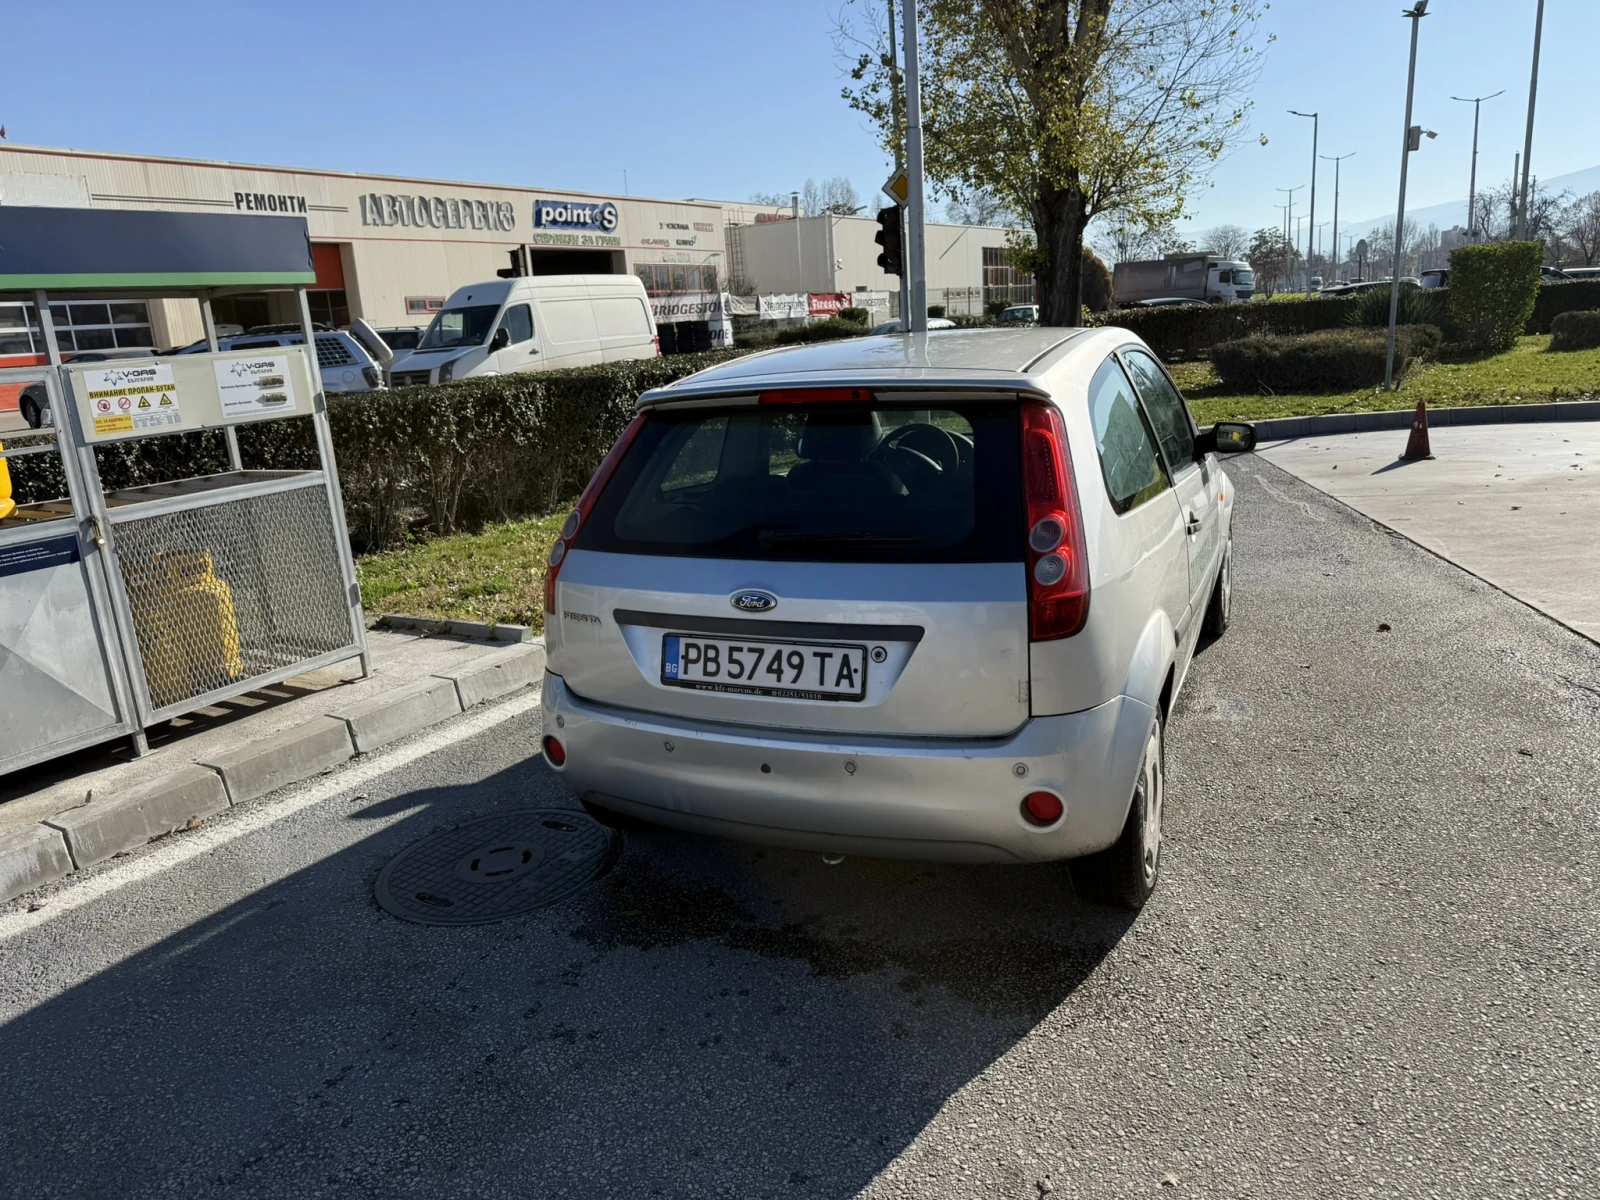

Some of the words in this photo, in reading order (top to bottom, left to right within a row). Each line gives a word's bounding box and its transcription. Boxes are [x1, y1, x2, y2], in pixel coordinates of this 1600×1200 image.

[234, 192, 307, 213] РЕМОНТИ
[541, 204, 592, 224] point
[603, 206, 617, 228] S
[246, 361, 275, 369] V-GAS
[122, 369, 157, 377] V-GAS
[89, 388, 127, 399] ВНИМАНИЕ
[128, 384, 175, 395] ПРОПАН-БУТАН
[739, 595, 765, 608] Ford
[563, 611, 602, 624] FIESTA
[665, 662, 678, 673] BG
[683, 642, 721, 677] PB
[727, 646, 805, 684] 5749
[812, 651, 855, 688] TA
[695, 684, 763, 696] www.kfz-marcus.de
